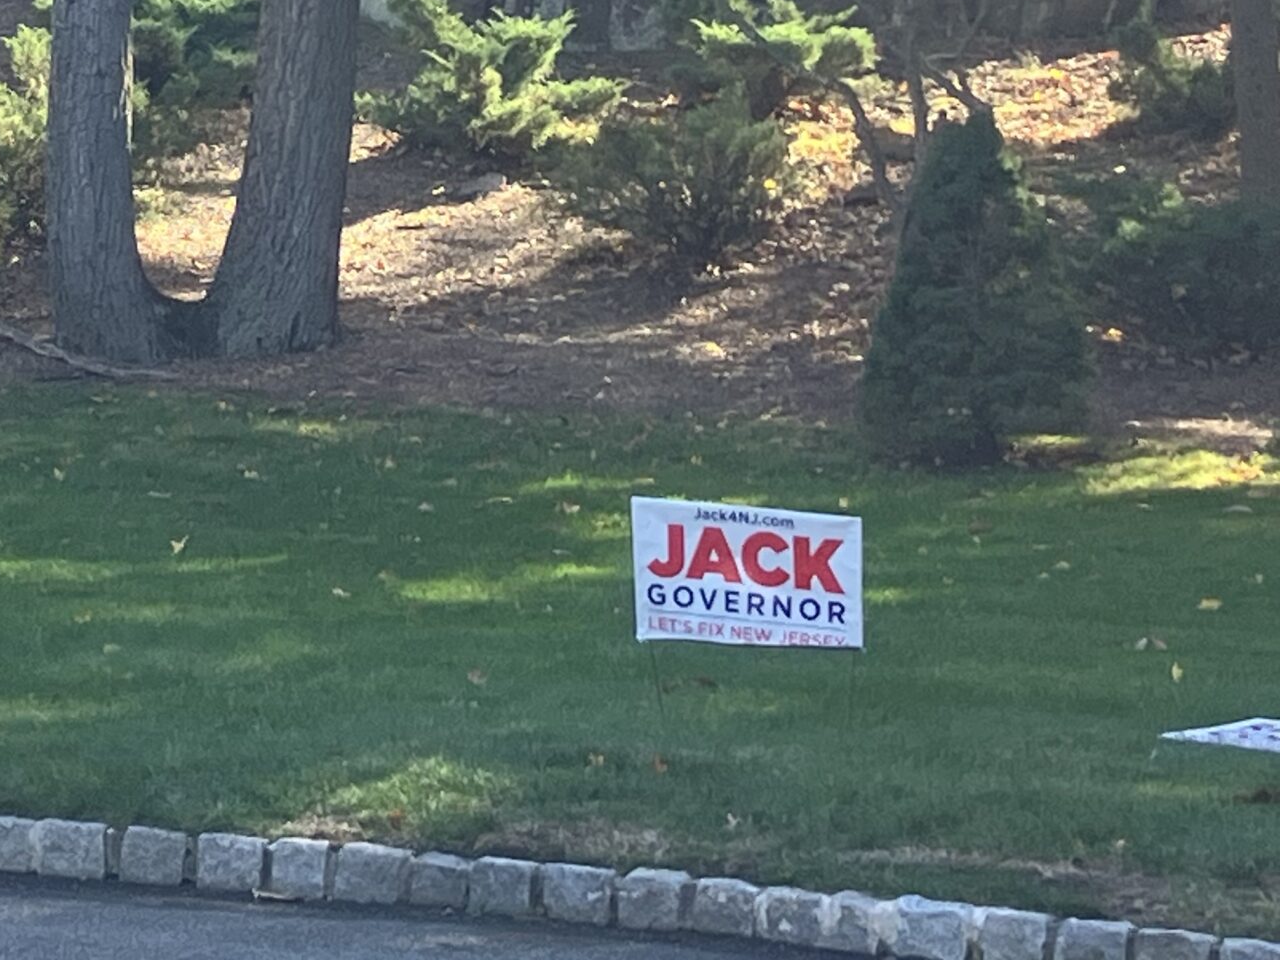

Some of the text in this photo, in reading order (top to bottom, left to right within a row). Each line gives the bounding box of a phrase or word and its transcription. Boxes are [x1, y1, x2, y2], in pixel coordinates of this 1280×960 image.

[694, 508, 795, 529] Jack4NJ.com
[648, 524, 846, 595] JACK
[648, 584, 846, 624] GOVERNOR
[648, 616, 693, 634] LET'S
[698, 621, 725, 639] FIX
[730, 626, 773, 642] NEW
